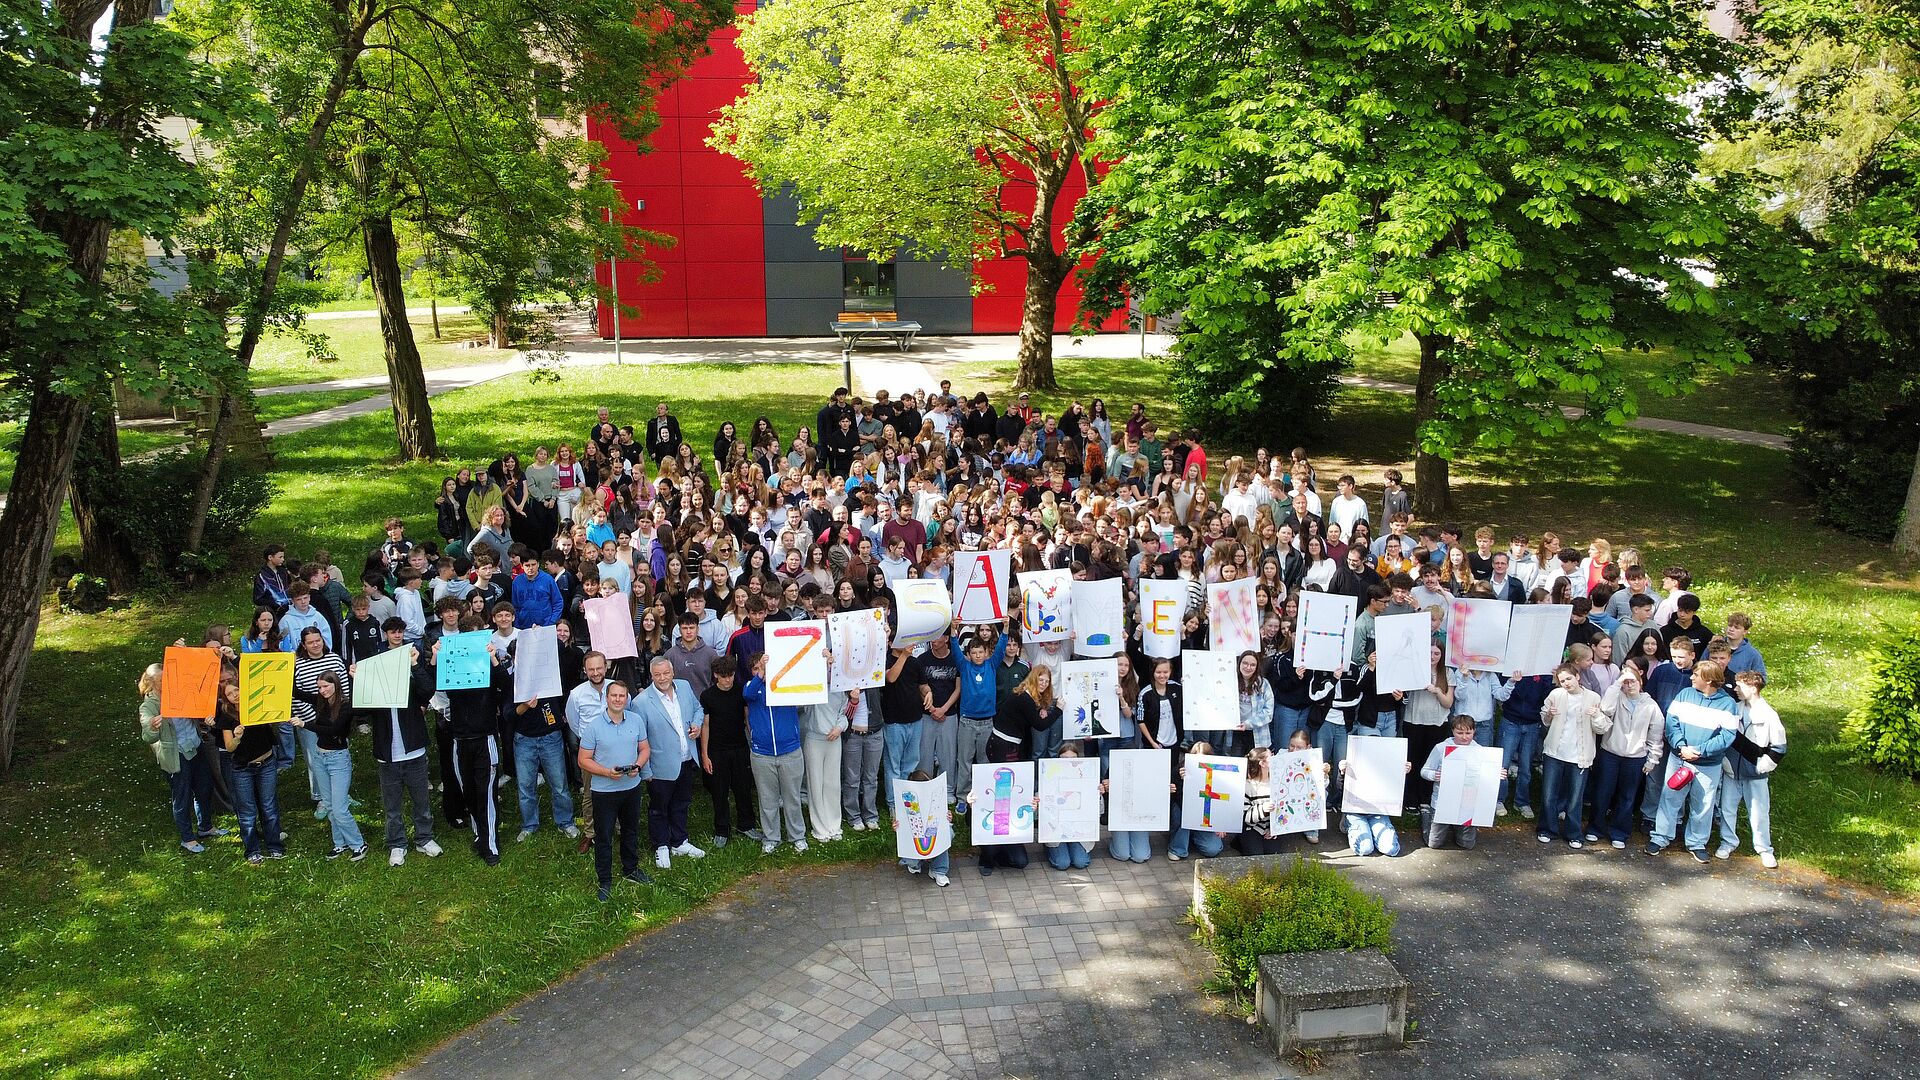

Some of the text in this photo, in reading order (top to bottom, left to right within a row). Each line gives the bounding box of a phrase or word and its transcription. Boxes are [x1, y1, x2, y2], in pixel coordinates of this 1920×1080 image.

[900, 583, 950, 643] S
[956, 555, 1007, 620] A
[1153, 599, 1177, 635] E
[1213, 587, 1255, 651] N
[447, 632, 491, 685] E
[770, 626, 824, 694] Z
[841, 623, 877, 679] U
[1301, 599, 1349, 667] H
[1451, 601, 1499, 665] L
[166, 658, 219, 711] W
[249, 660, 289, 722] E
[362, 646, 406, 704] N
[902, 788, 943, 856] V
[1199, 762, 1239, 827] F
